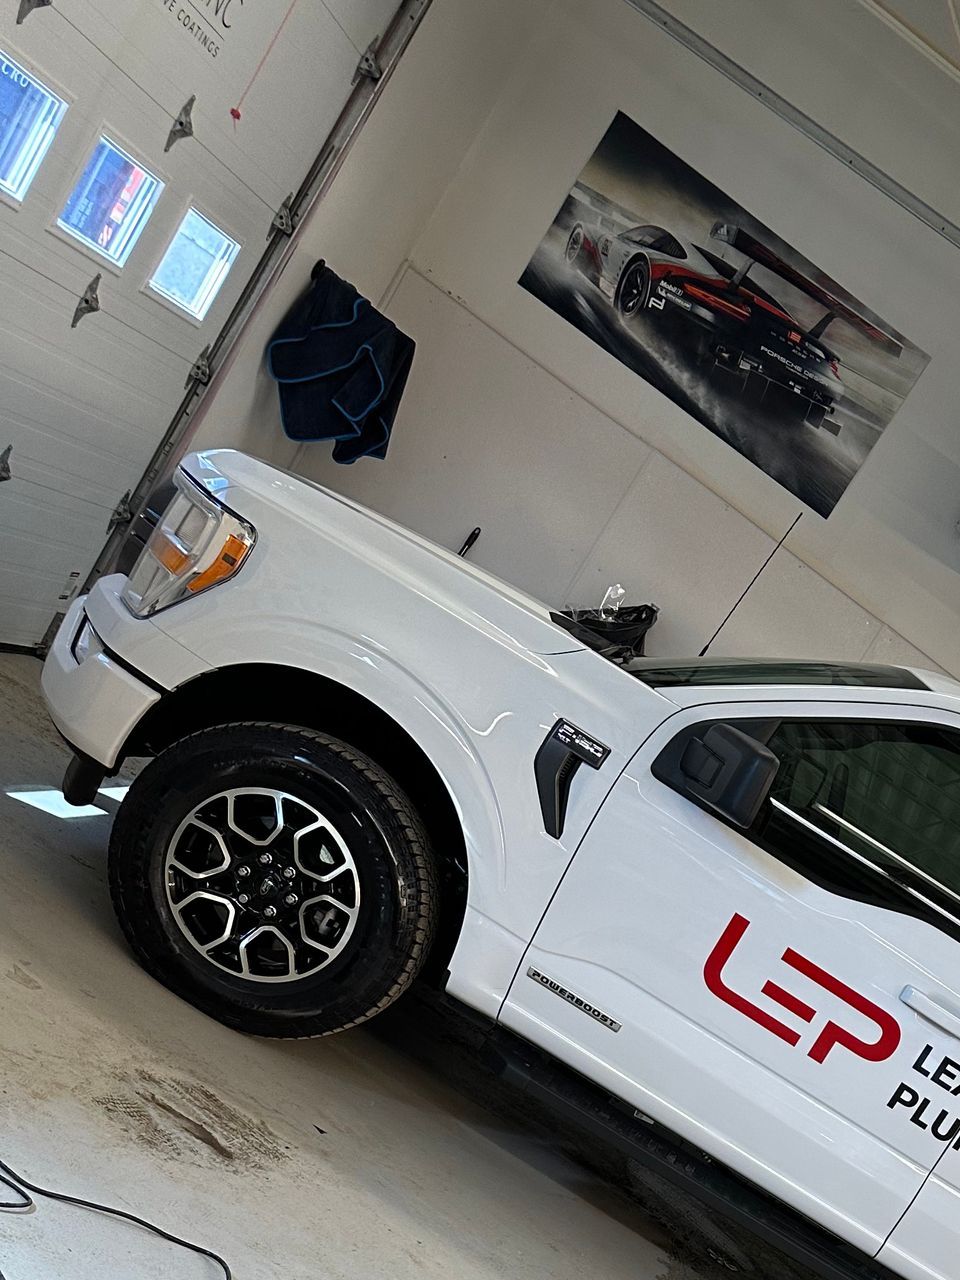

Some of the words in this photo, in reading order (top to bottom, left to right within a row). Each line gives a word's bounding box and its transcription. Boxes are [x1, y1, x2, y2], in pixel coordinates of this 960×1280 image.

[176, 8, 220, 58] COATINGS
[531, 969, 618, 1028] POWERBOOST
[703, 912, 902, 1065] LEP
